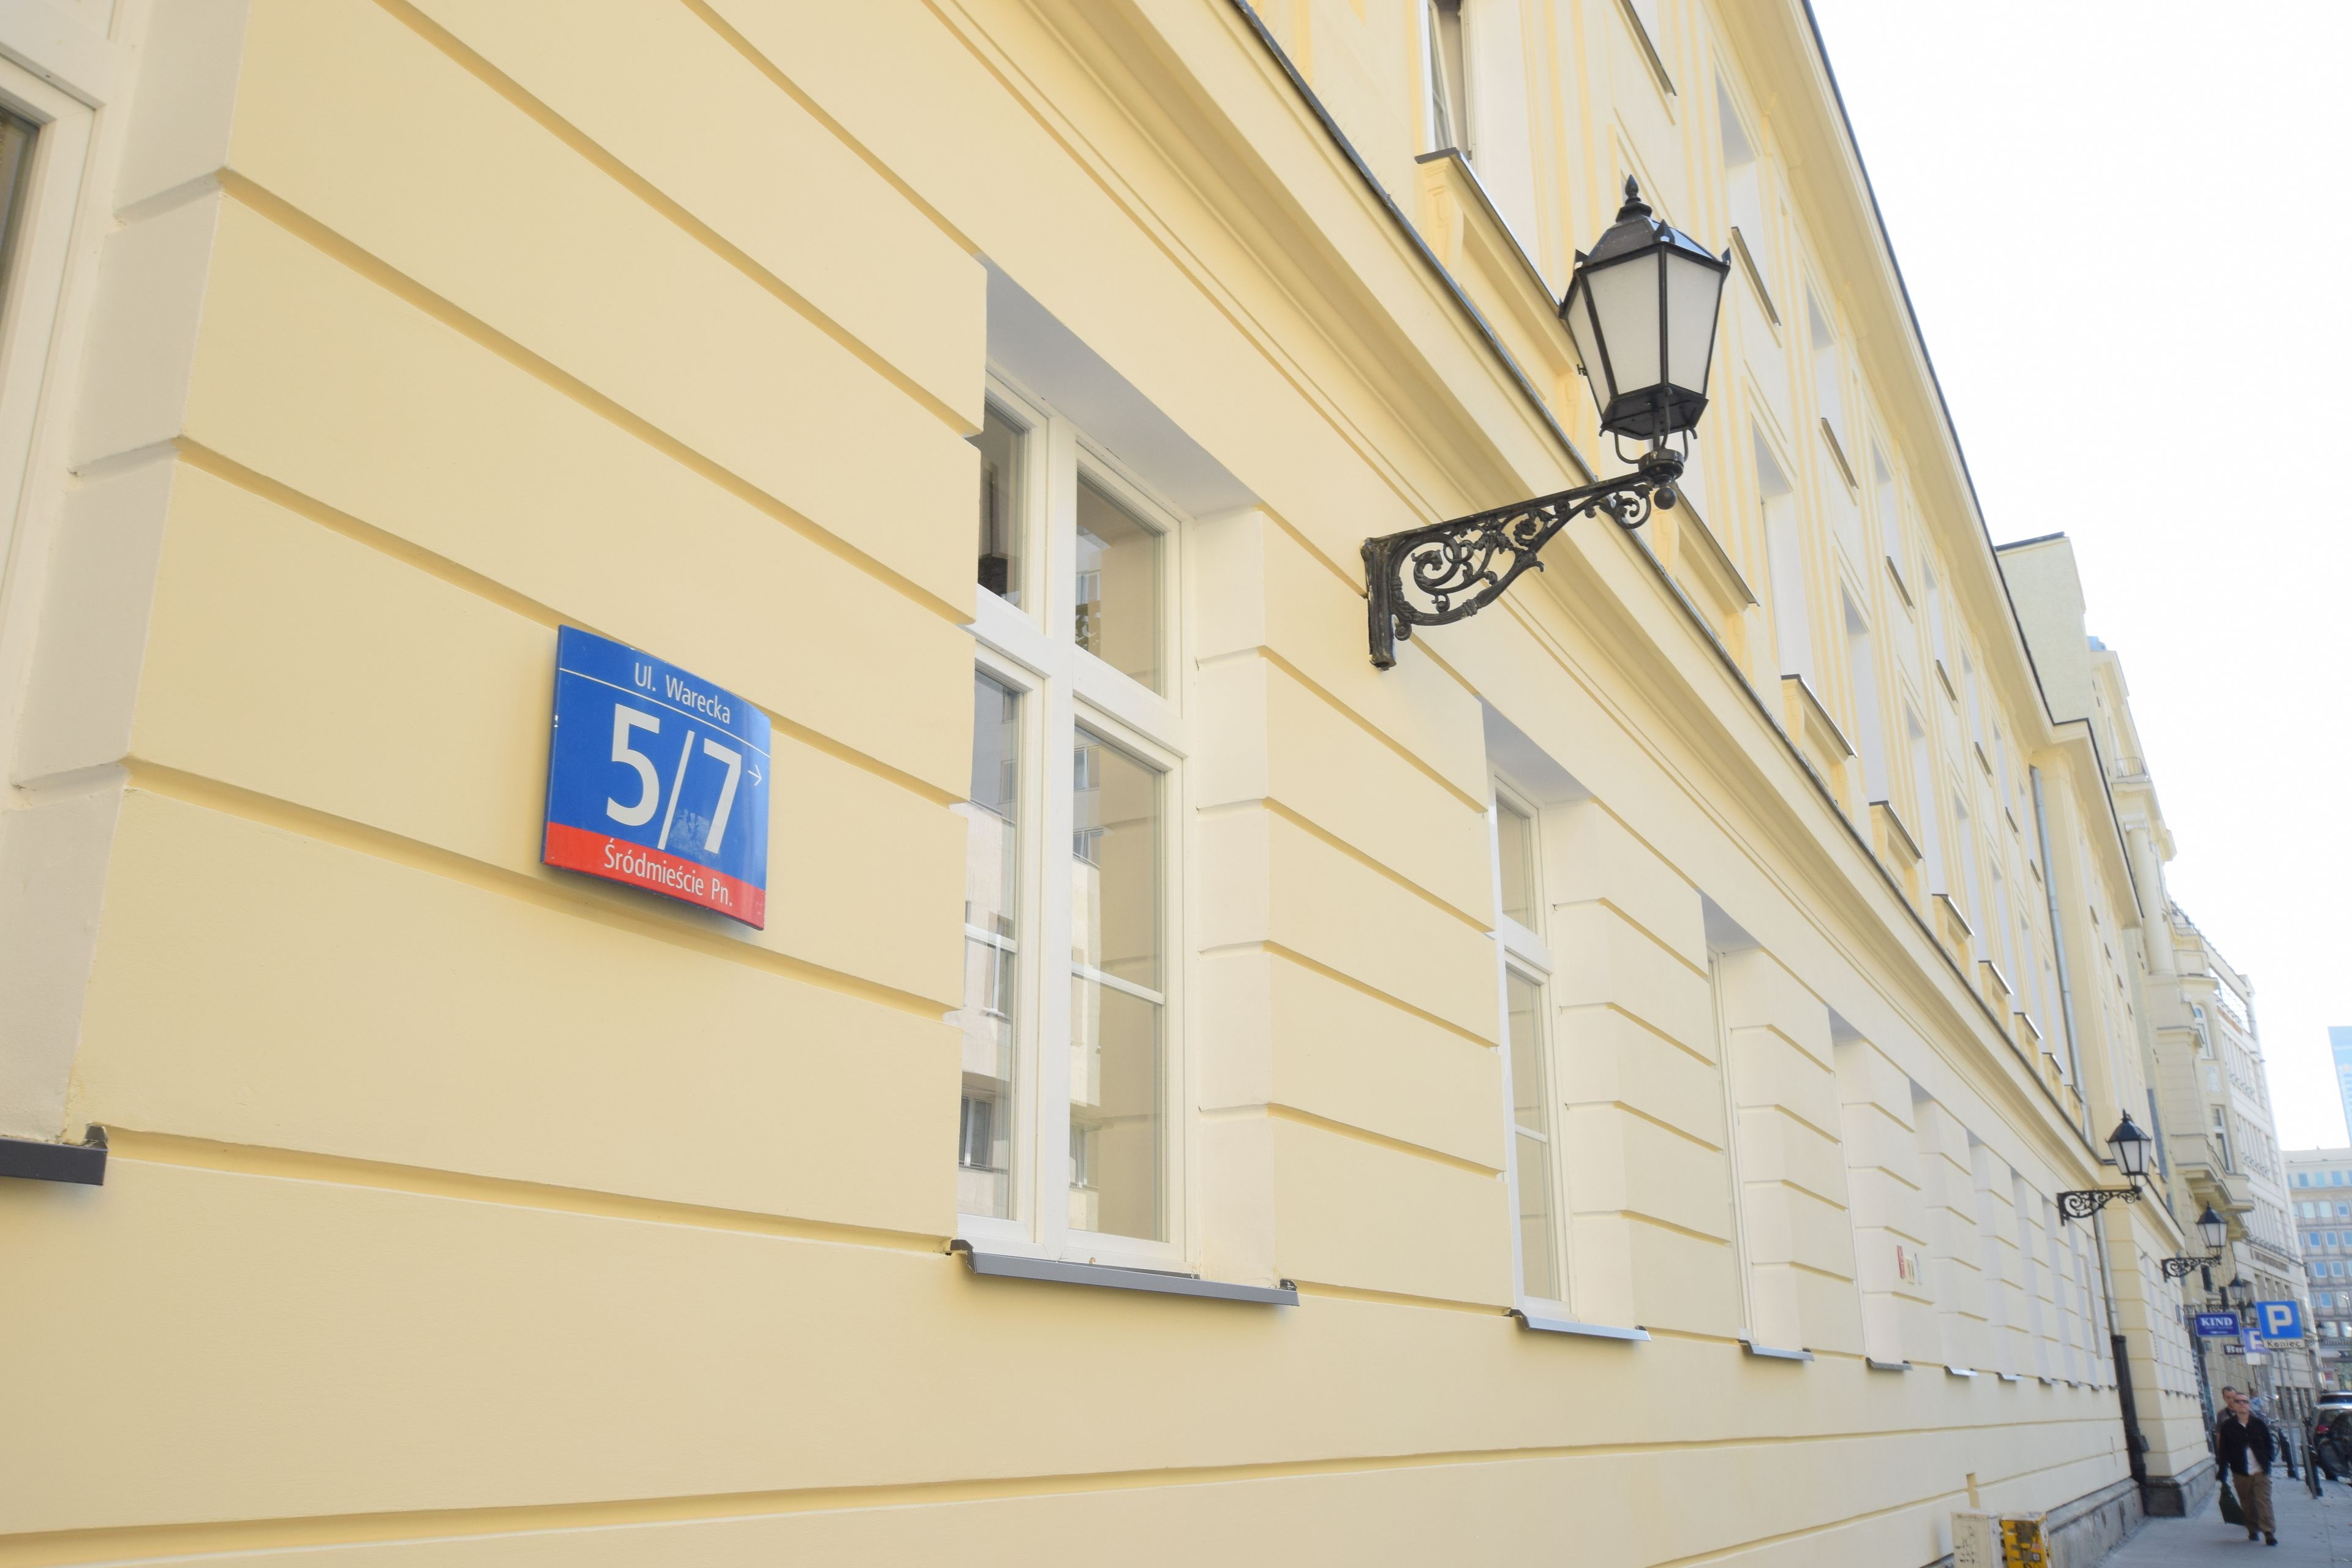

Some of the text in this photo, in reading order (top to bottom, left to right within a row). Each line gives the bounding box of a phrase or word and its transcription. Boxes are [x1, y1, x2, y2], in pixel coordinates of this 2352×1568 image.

[635, 662, 730, 724] Ul. Warecka
[606, 703, 742, 854] 5/7
[604, 838, 733, 907] Śródmieście Pn.
[2200, 1317, 2233, 1326] KIND
[2266, 1305, 2293, 1335] P
